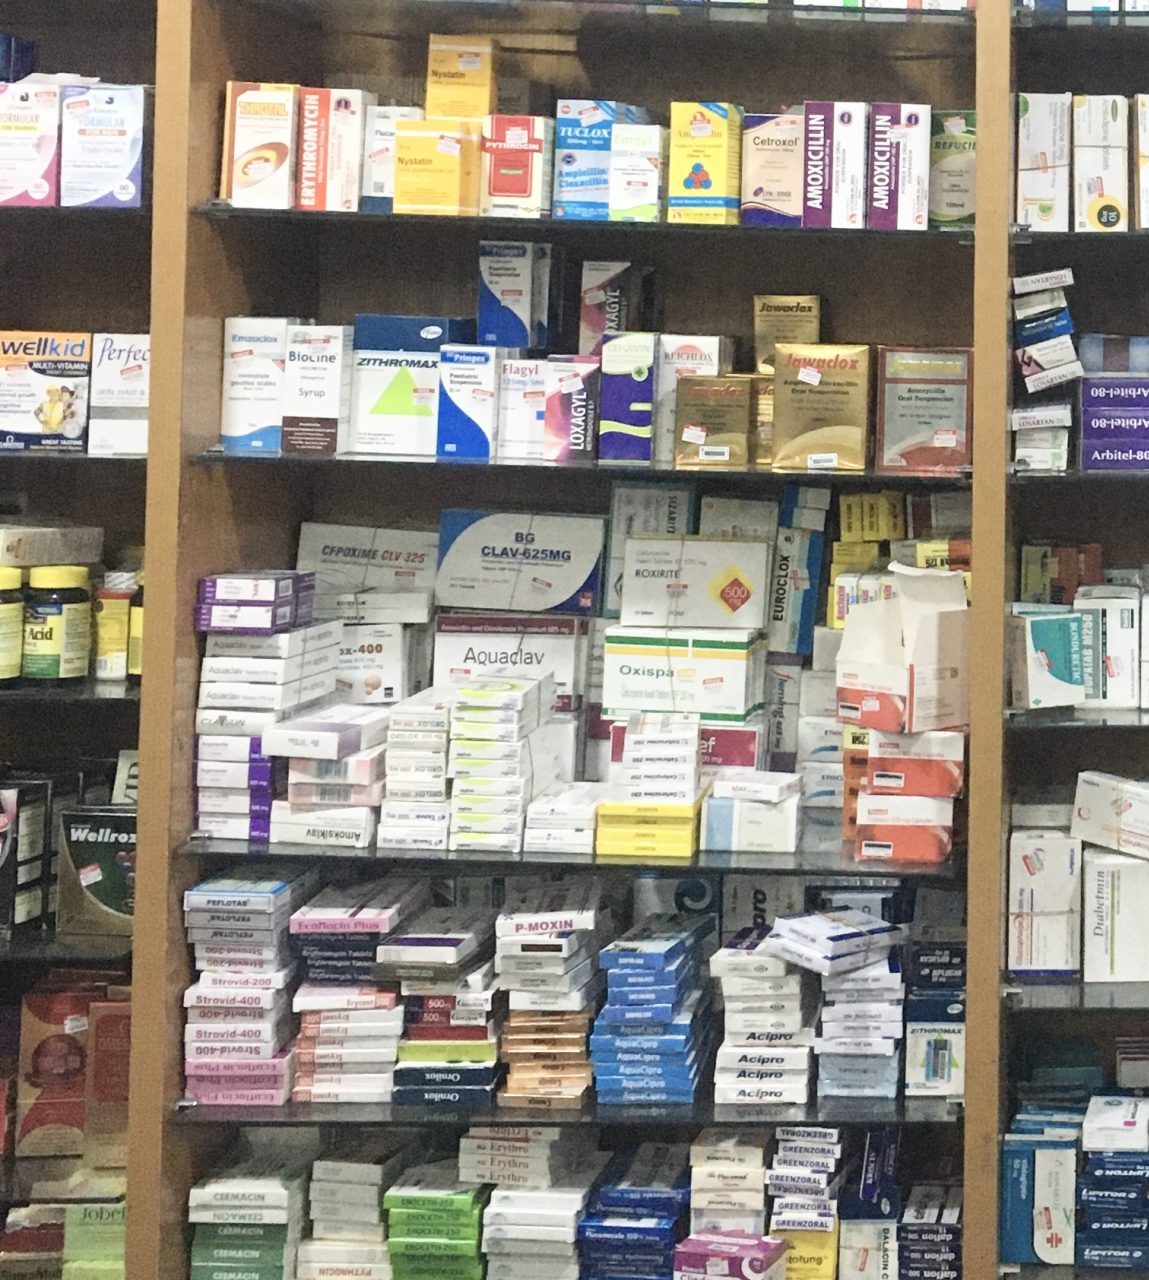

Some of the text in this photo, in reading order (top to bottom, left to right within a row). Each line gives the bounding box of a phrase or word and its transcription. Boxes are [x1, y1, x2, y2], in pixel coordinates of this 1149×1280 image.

[431, 70, 466, 80] Nystatin
[753, 136, 798, 148] Cetroxol
[301, 94, 320, 206] ERYTHROMYCIN
[398, 157, 433, 166] Nystatin
[806, 115, 825, 209] AMOXICILLIN
[873, 115, 891, 210] AMOXICILLIN
[760, 303, 814, 314] Jawaclox
[231, 333, 278, 343] Emzoclox
[1, 337, 86, 356] wellkid
[357, 357, 440, 369] ZITHROMAX
[784, 353, 859, 370] Jawaclox
[502, 363, 539, 376] Flagyl
[297, 388, 325, 399] Syrup
[1091, 387, 1149, 398] Arbitel-80
[569, 391, 587, 450] LOXAGYL
[514, 532, 536, 543] BG
[481, 546, 572, 561] CLAV-625MG
[634, 569, 679, 579] ROXIRITE
[725, 586, 748, 600] 500
[772, 554, 790, 622] EUROCLOX
[28, 627, 54, 641] Acid
[463, 647, 545, 666] Aquaclav
[619, 665, 674, 678] Oxispa
[306, 828, 361, 841] Amoksiklav
[1093, 871, 1105, 937] Diabetmin
[353, 921, 380, 930] Plus
[515, 918, 574, 934] P-MOXIN
[211, 978, 272, 986] Strovid-200
[195, 995, 262, 1006] Strovid-400
[195, 1030, 262, 1039] Strovid-400
[911, 1027, 962, 1035] ZITHROMAX
[746, 1032, 793, 1042] Acipro
[614, 1038, 658, 1049] AquaCipro
[738, 1054, 784, 1065] Acipro
[736, 1088, 783, 1099] Acipro
[782, 1145, 836, 1156] GREENZORAL
[776, 1159, 831, 1170] GREENZORAL
[768, 1174, 822, 1185] GREENZORAL
[1082, 1188, 1128, 1198] LIPITOR
[778, 1201, 833, 1212] GREENZORAL
[775, 1219, 830, 1230] GREENZORAL
[1084, 1248, 1130, 1257] LIPITOR
